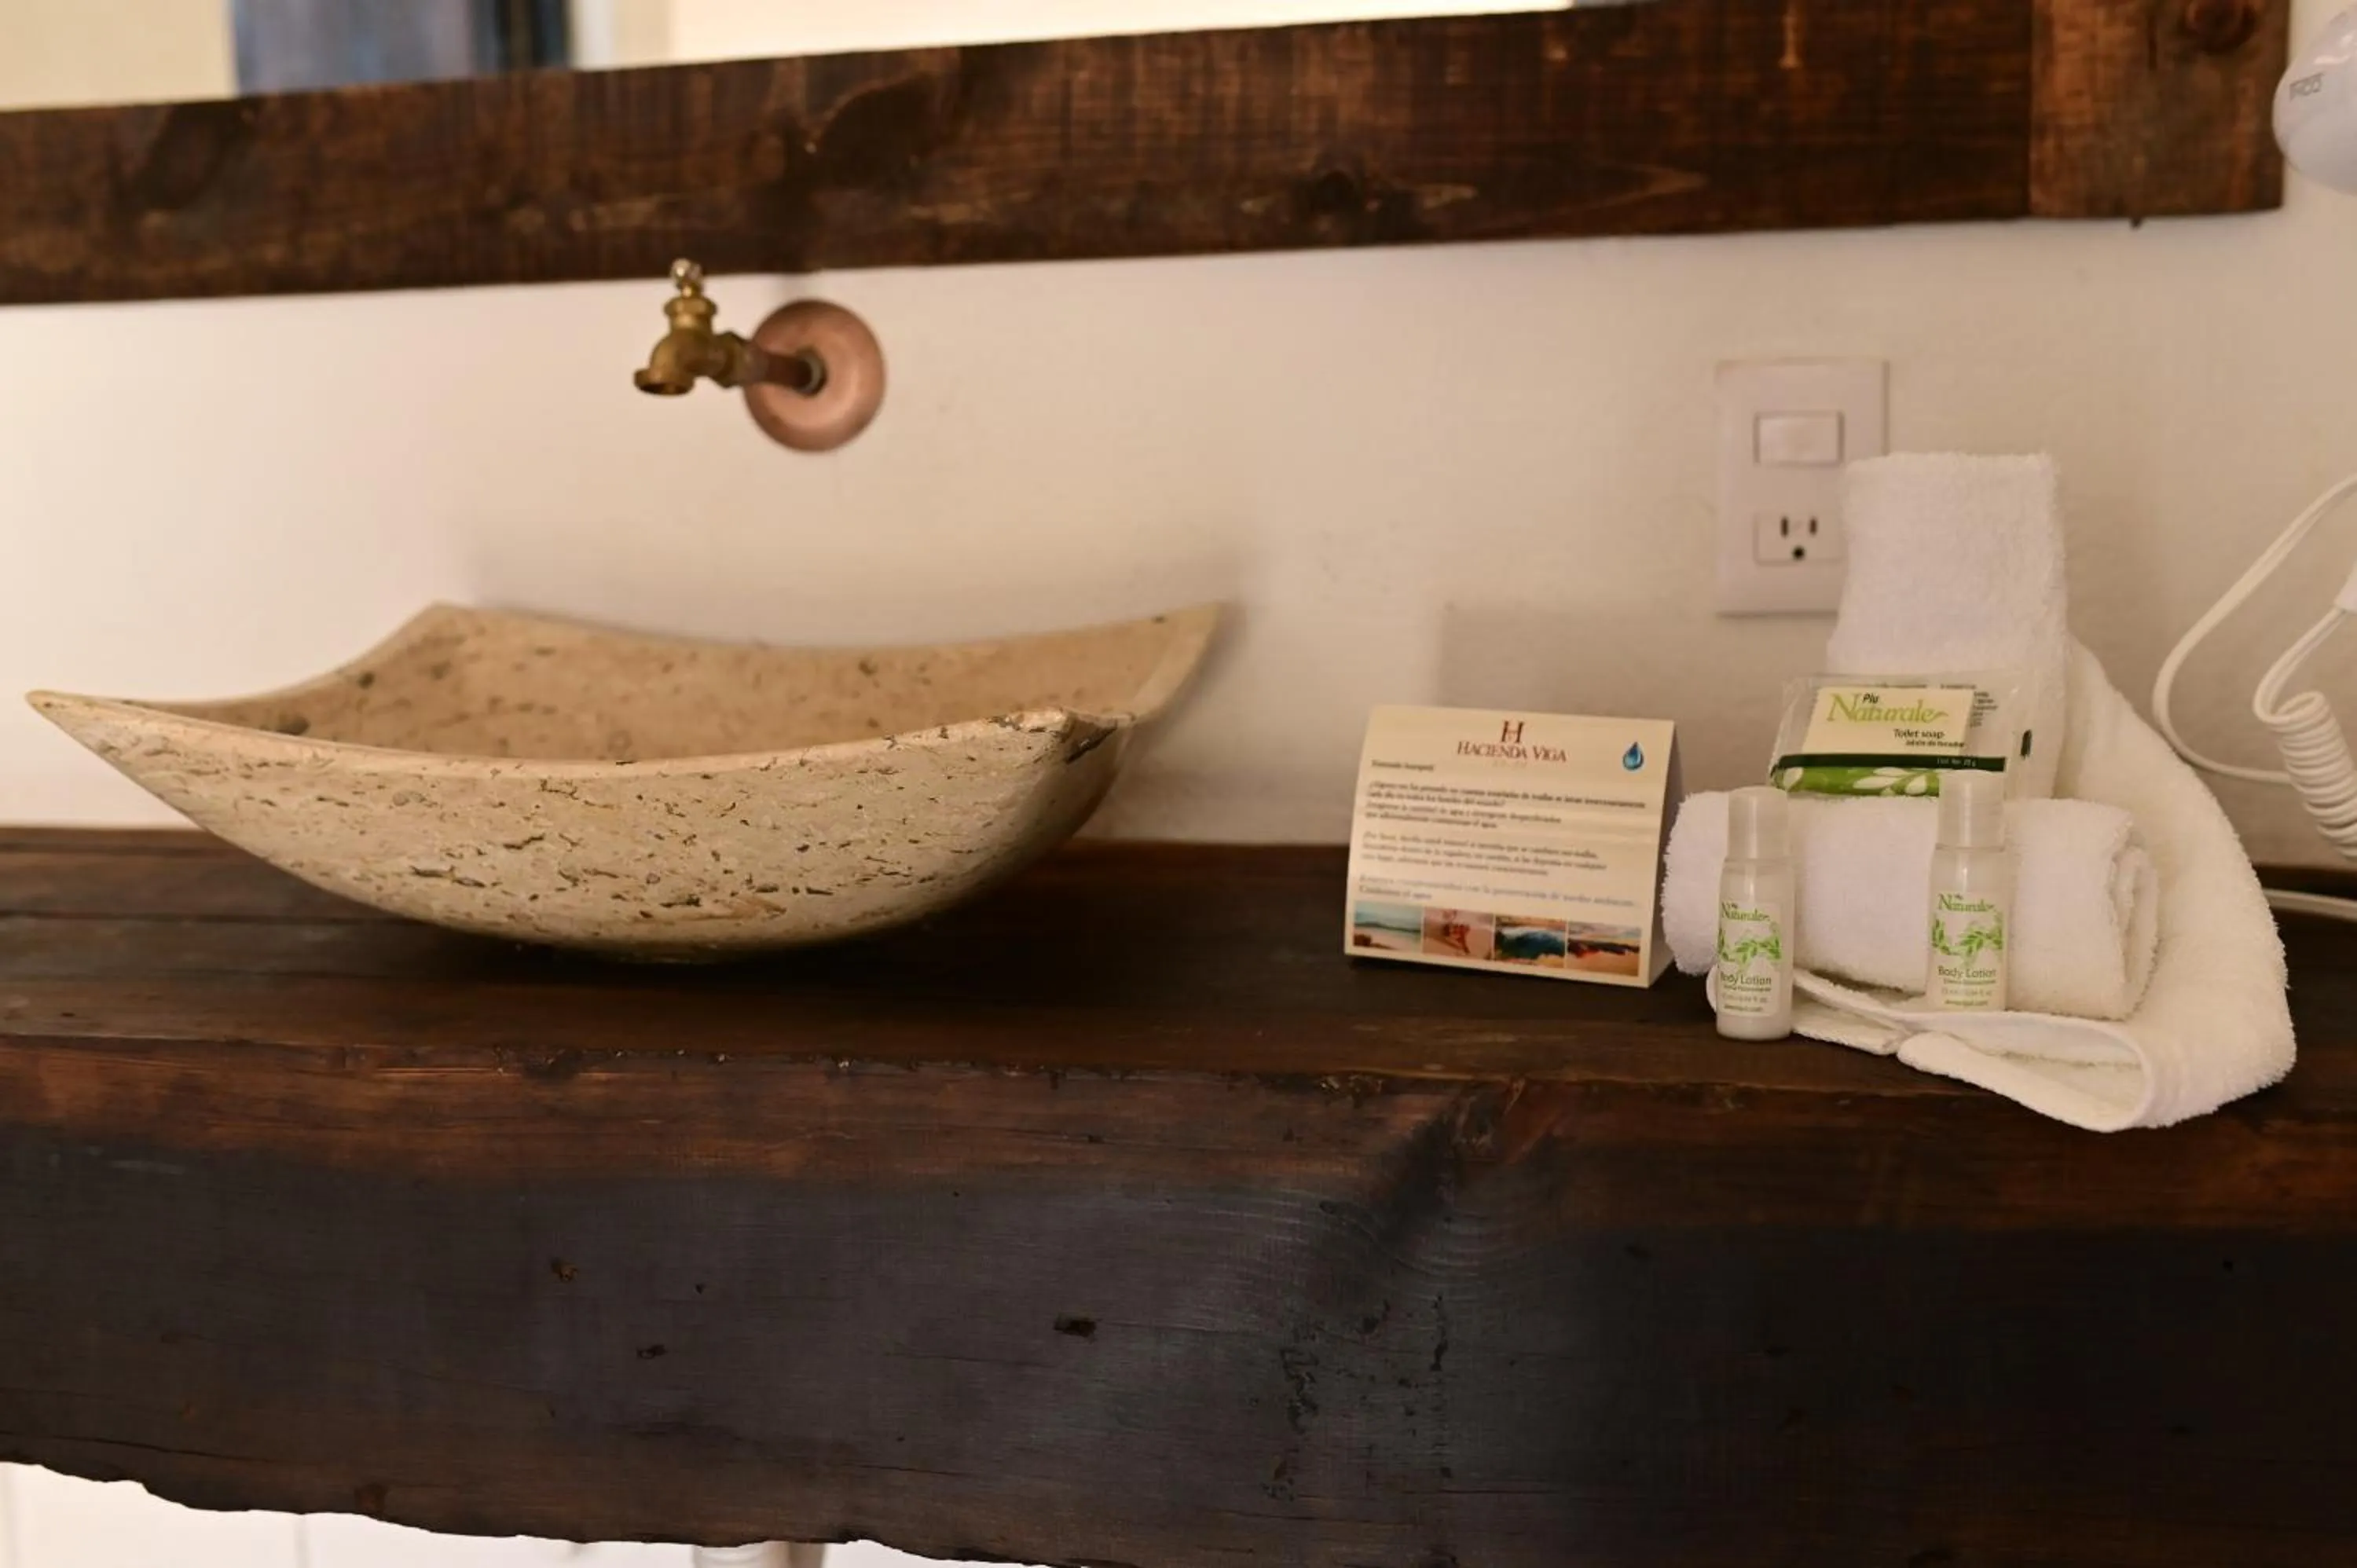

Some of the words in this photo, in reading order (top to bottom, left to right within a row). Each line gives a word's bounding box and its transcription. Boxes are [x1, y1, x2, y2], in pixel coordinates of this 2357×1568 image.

[1827, 694, 1948, 724] Naturale
[1893, 728, 1919, 738] Toilet
[1921, 730, 1945, 740] soap
[1457, 740, 1528, 760] HACIENDA
[1532, 745, 1567, 763] VIGA
[1937, 965, 1964, 978] Body
[1965, 967, 1996, 978] Lotion
[1740, 973, 1772, 985] Lotion
